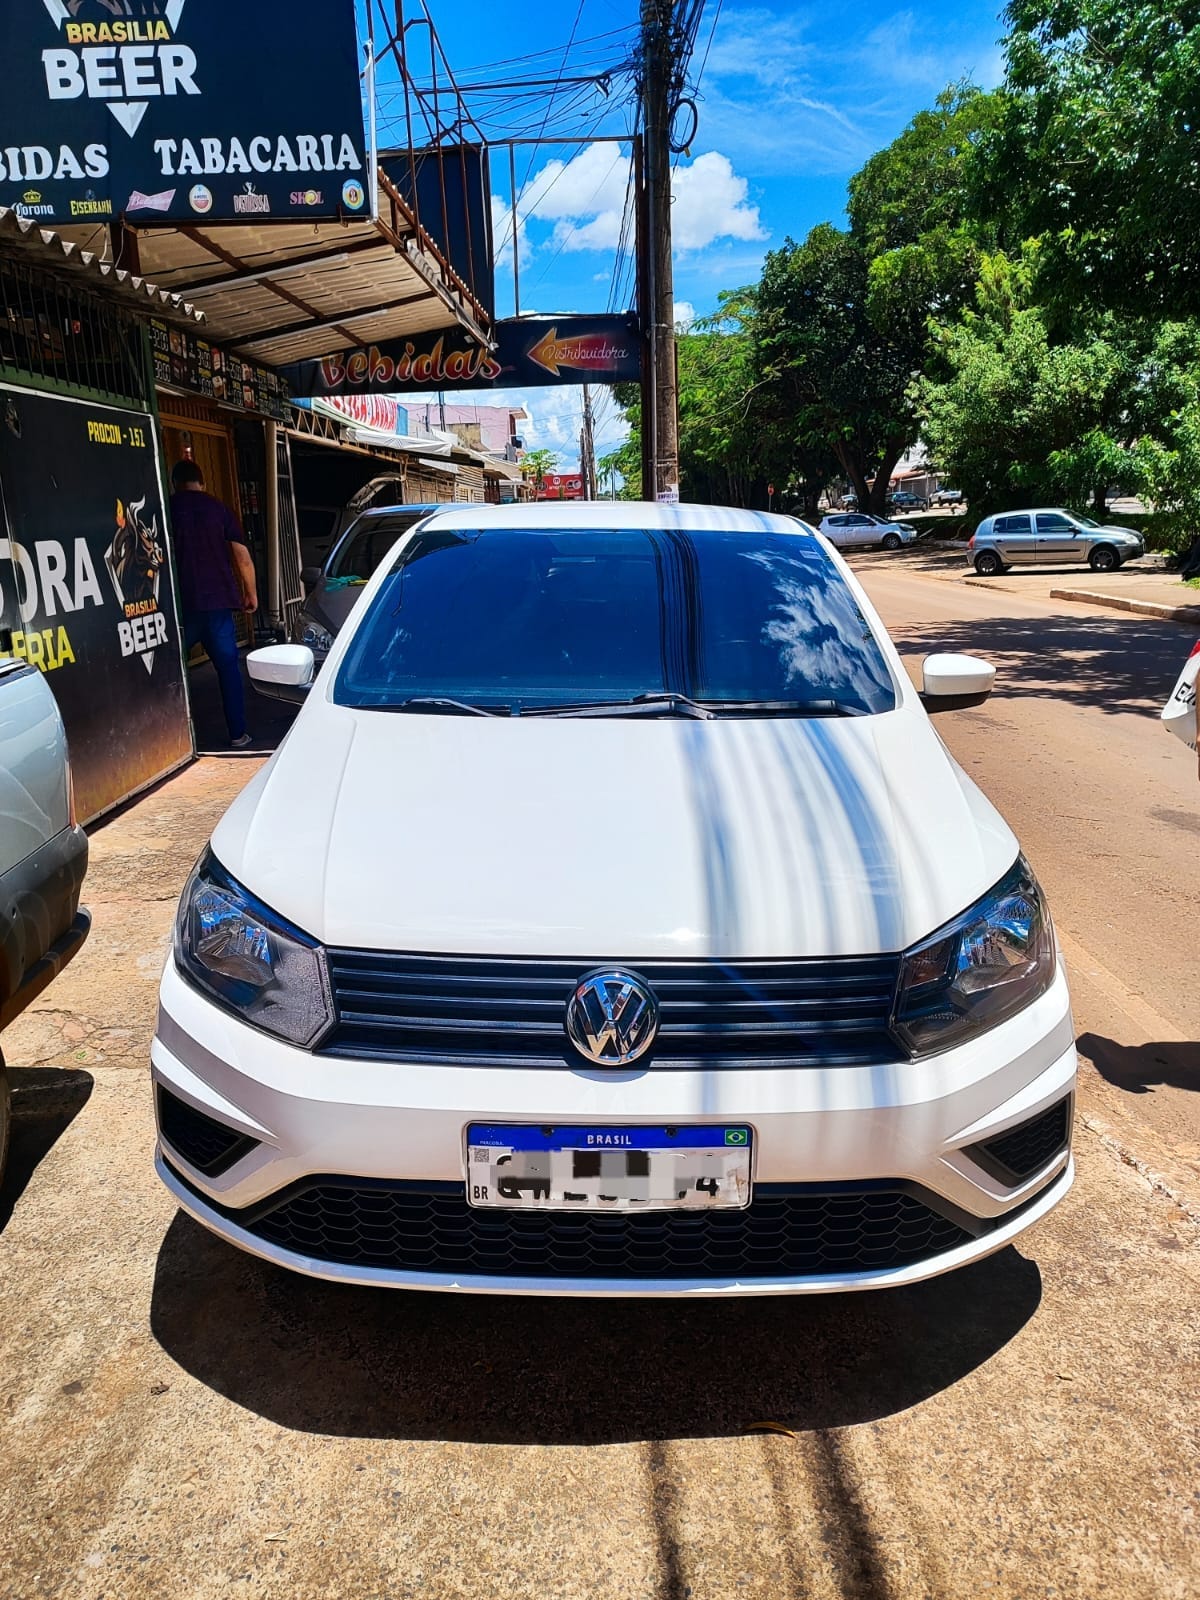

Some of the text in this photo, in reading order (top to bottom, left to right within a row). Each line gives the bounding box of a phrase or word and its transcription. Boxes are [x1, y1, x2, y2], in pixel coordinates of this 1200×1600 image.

[65, 20, 170, 44] BRASILIA
[41, 44, 202, 100] BEER
[0, 133, 362, 182] IDAS TABACARIA
[11, 202, 55, 217] Corona
[320, 336, 502, 388] Bebidas
[542, 341, 630, 360] Distribuidora
[87, 421, 122, 445] PROCON
[128, 426, 146, 448] 151
[124, 598, 158, 618] BRASILIA
[117, 612, 169, 657] BEER
[587, 1134, 632, 1145] BRASIL
[473, 1185, 489, 1200] BR
